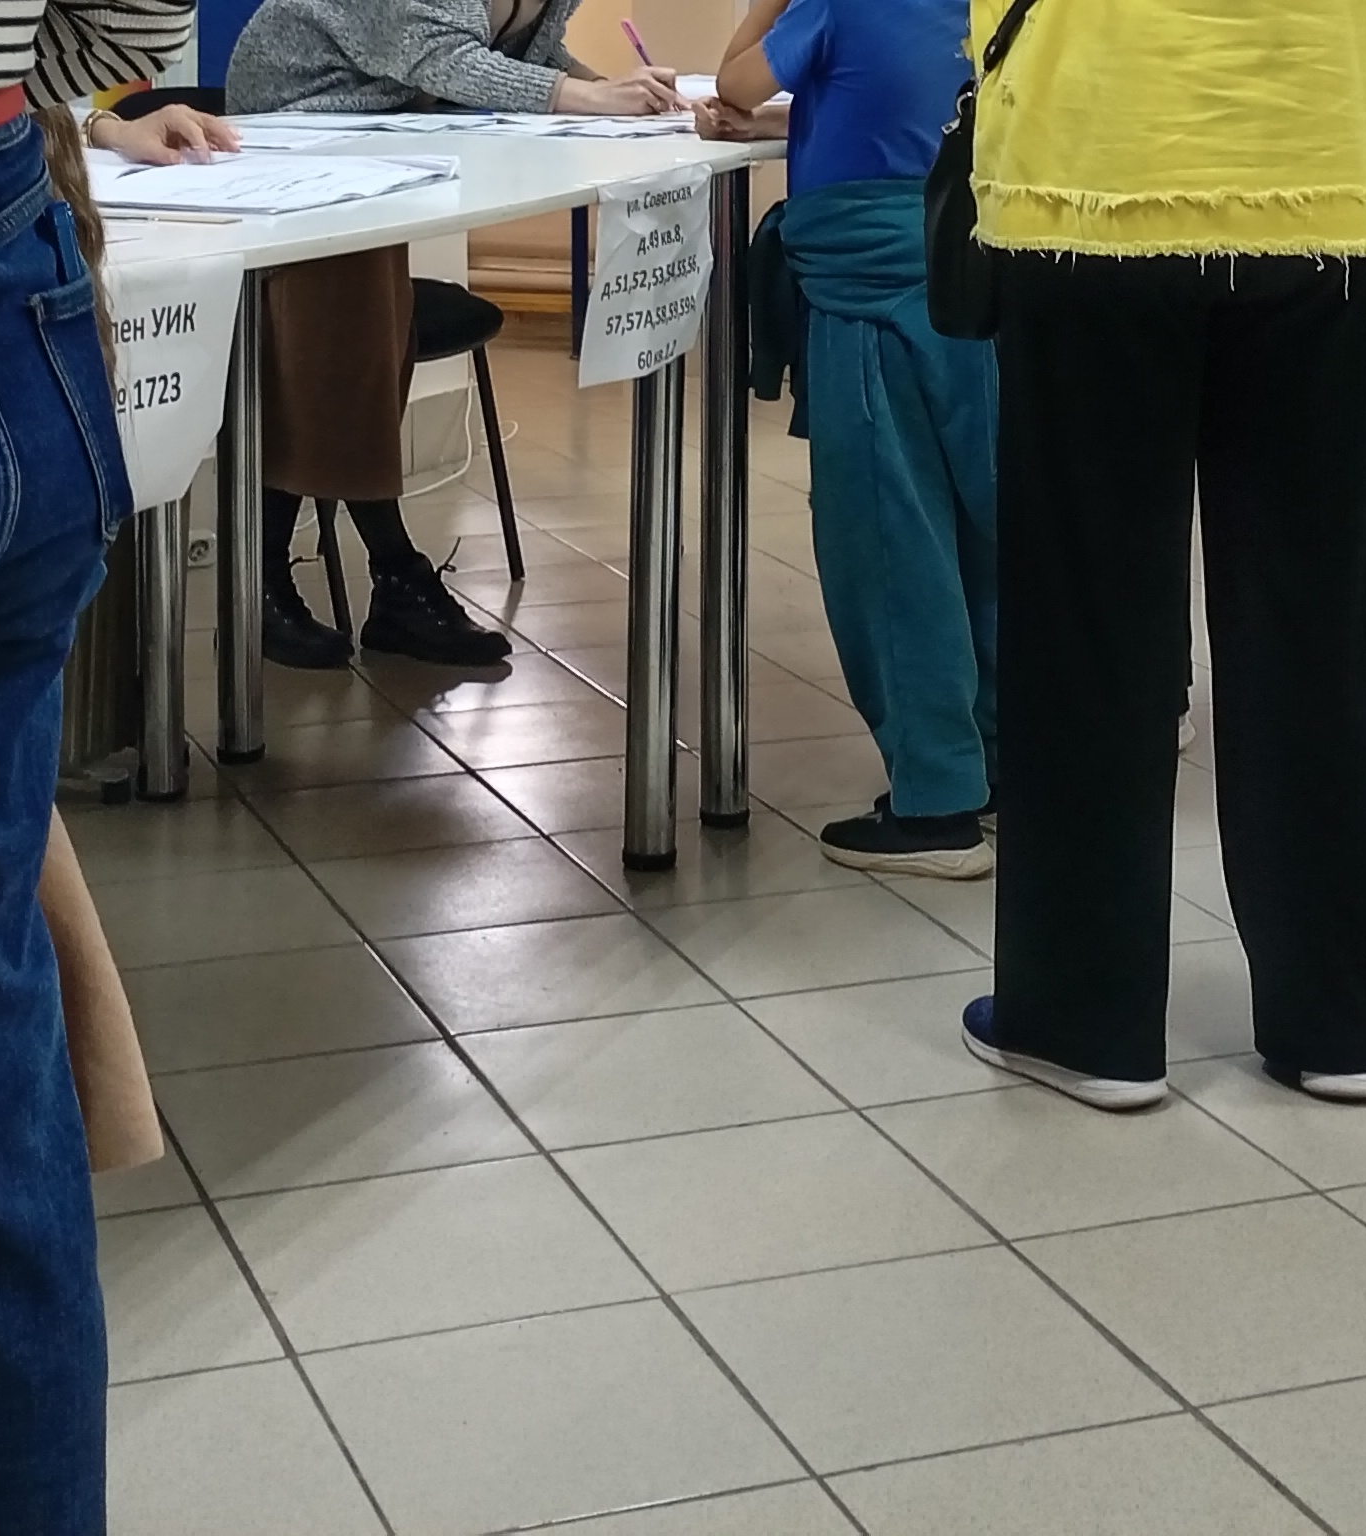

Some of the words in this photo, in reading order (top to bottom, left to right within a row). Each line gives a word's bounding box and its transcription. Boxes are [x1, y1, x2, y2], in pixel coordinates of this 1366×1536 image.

[643, 186, 692, 210] Советская
[637, 229, 659, 256] д.49
[661, 224, 684, 246] кв.8,
[151, 302, 197, 337] УИК
[637, 350, 653, 370] 60
[133, 371, 182, 410] 1723
